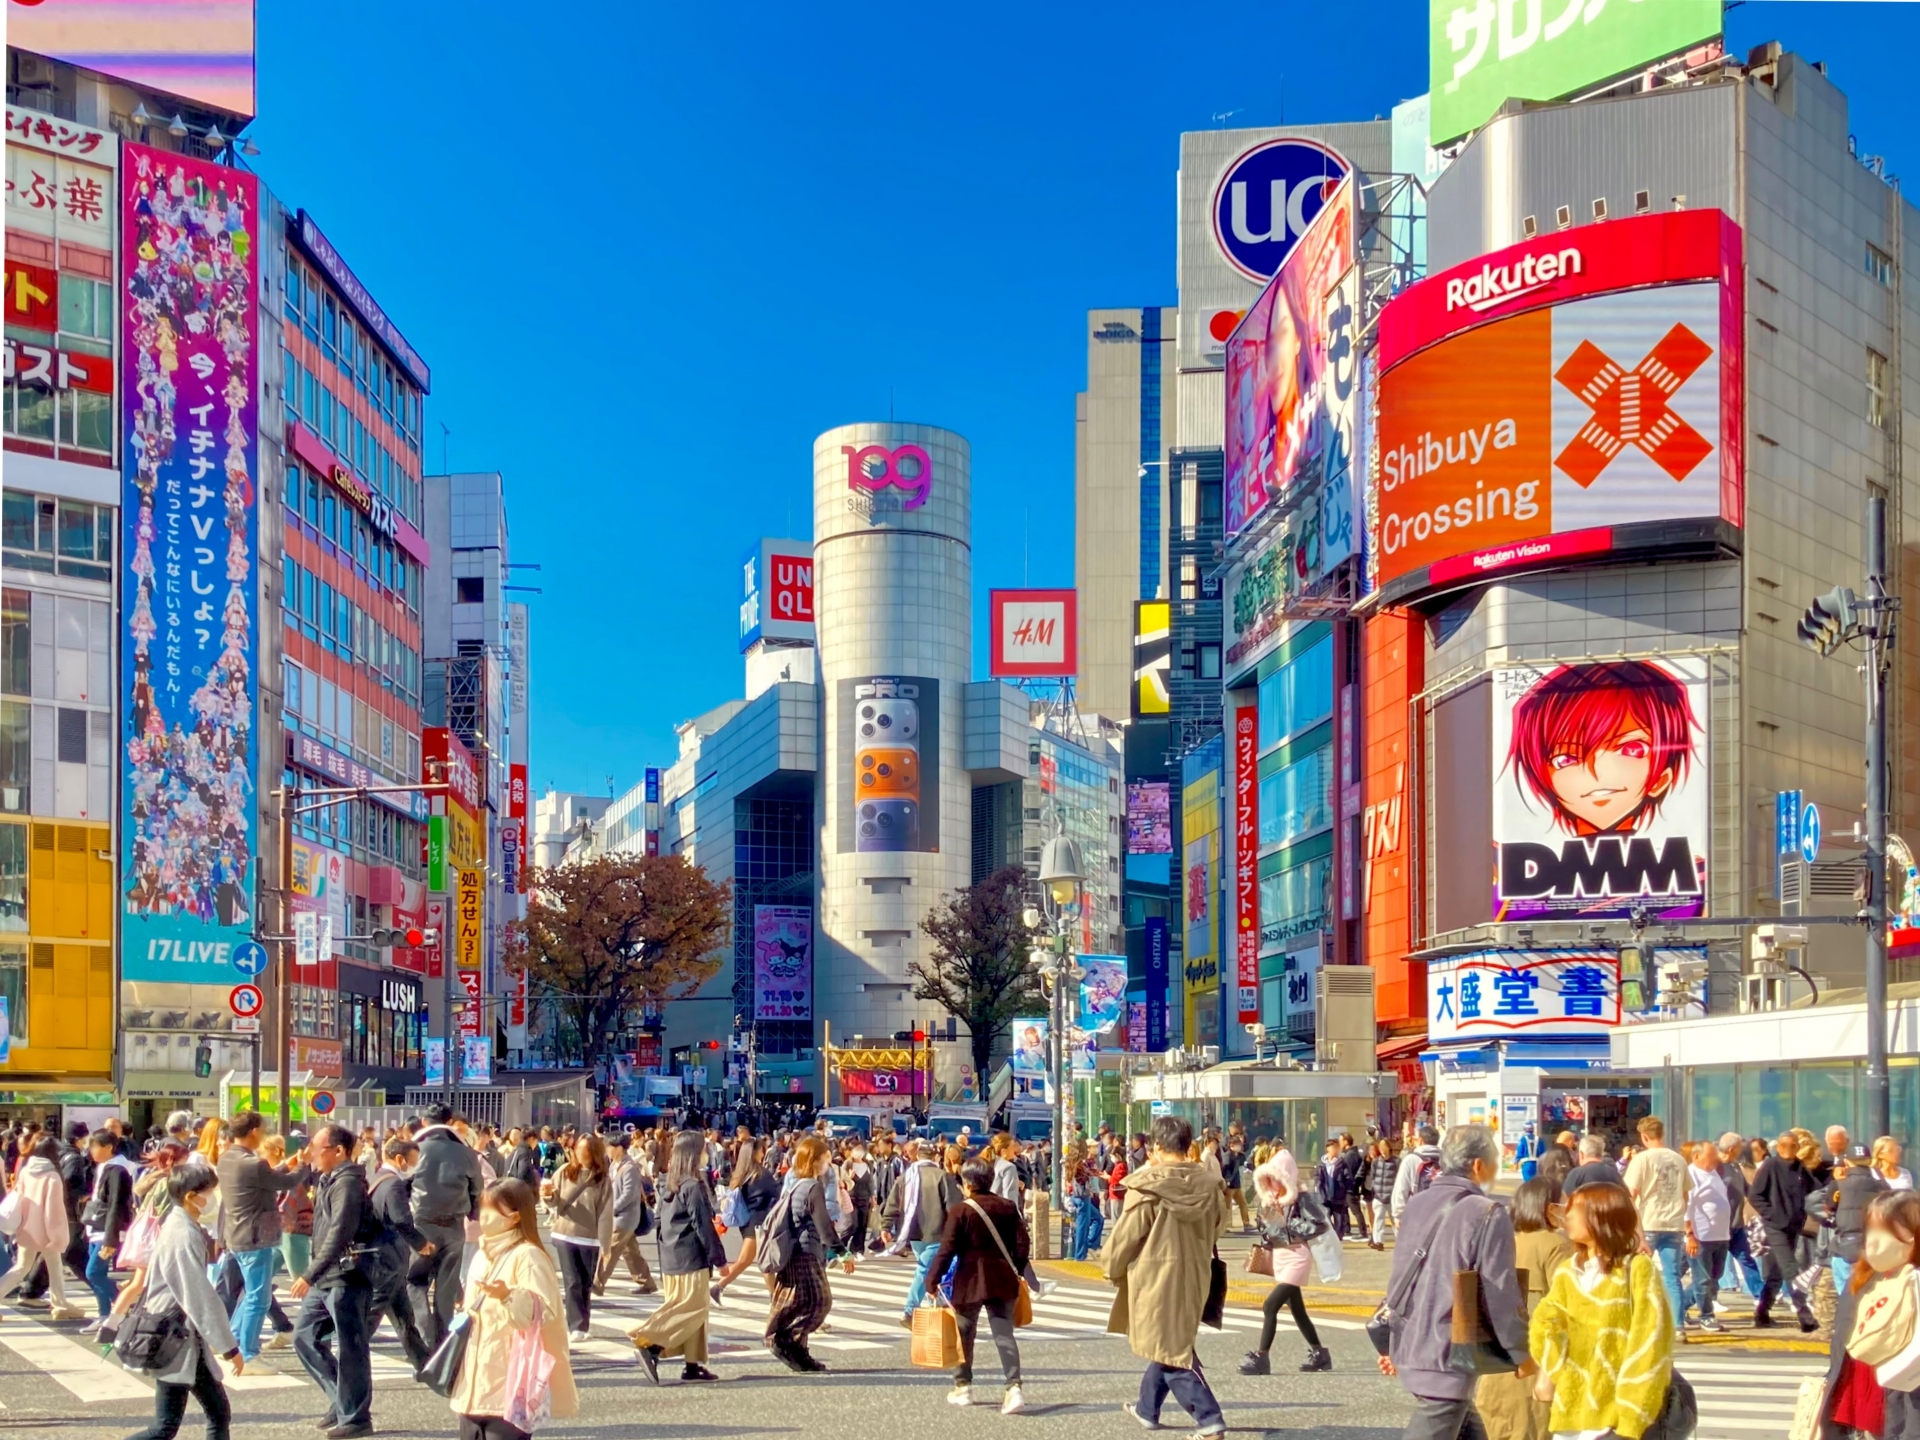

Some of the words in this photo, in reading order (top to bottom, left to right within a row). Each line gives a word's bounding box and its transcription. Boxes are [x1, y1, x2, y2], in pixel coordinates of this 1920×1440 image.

[4, 270, 48, 311] ト
[1446, 247, 1581, 311] Rakuten
[1093, 329, 1135, 339] INDIGO
[1325, 284, 1355, 555] もんじゃ
[1383, 416, 1516, 492] Shibuya
[841, 445, 932, 511] 109
[371, 495, 398, 539] ガスト
[1383, 480, 1540, 555] Crossing
[778, 563, 812, 588] UN
[1473, 553, 1515, 570] Rakuten
[1516, 542, 1550, 561] Vision
[778, 590, 812, 617] QL
[1012, 618, 1056, 647] H&M
[855, 684, 919, 699] PRO
[1238, 737, 1254, 914] ウィンターフルーツギフト
[1364, 761, 1405, 914] クスリ
[431, 841, 440, 864] レイク
[1501, 836, 1701, 898] DMM
[461, 872, 478, 938] 処方せん
[147, 939, 230, 965] 17LIVE
[464, 939, 475, 963] 3F
[1153, 928, 1161, 969] MIZUHO
[382, 979, 416, 1014] LUSH
[1151, 1000, 1161, 1044] みずほ銀行
[1854, 1146, 1865, 1156] H
